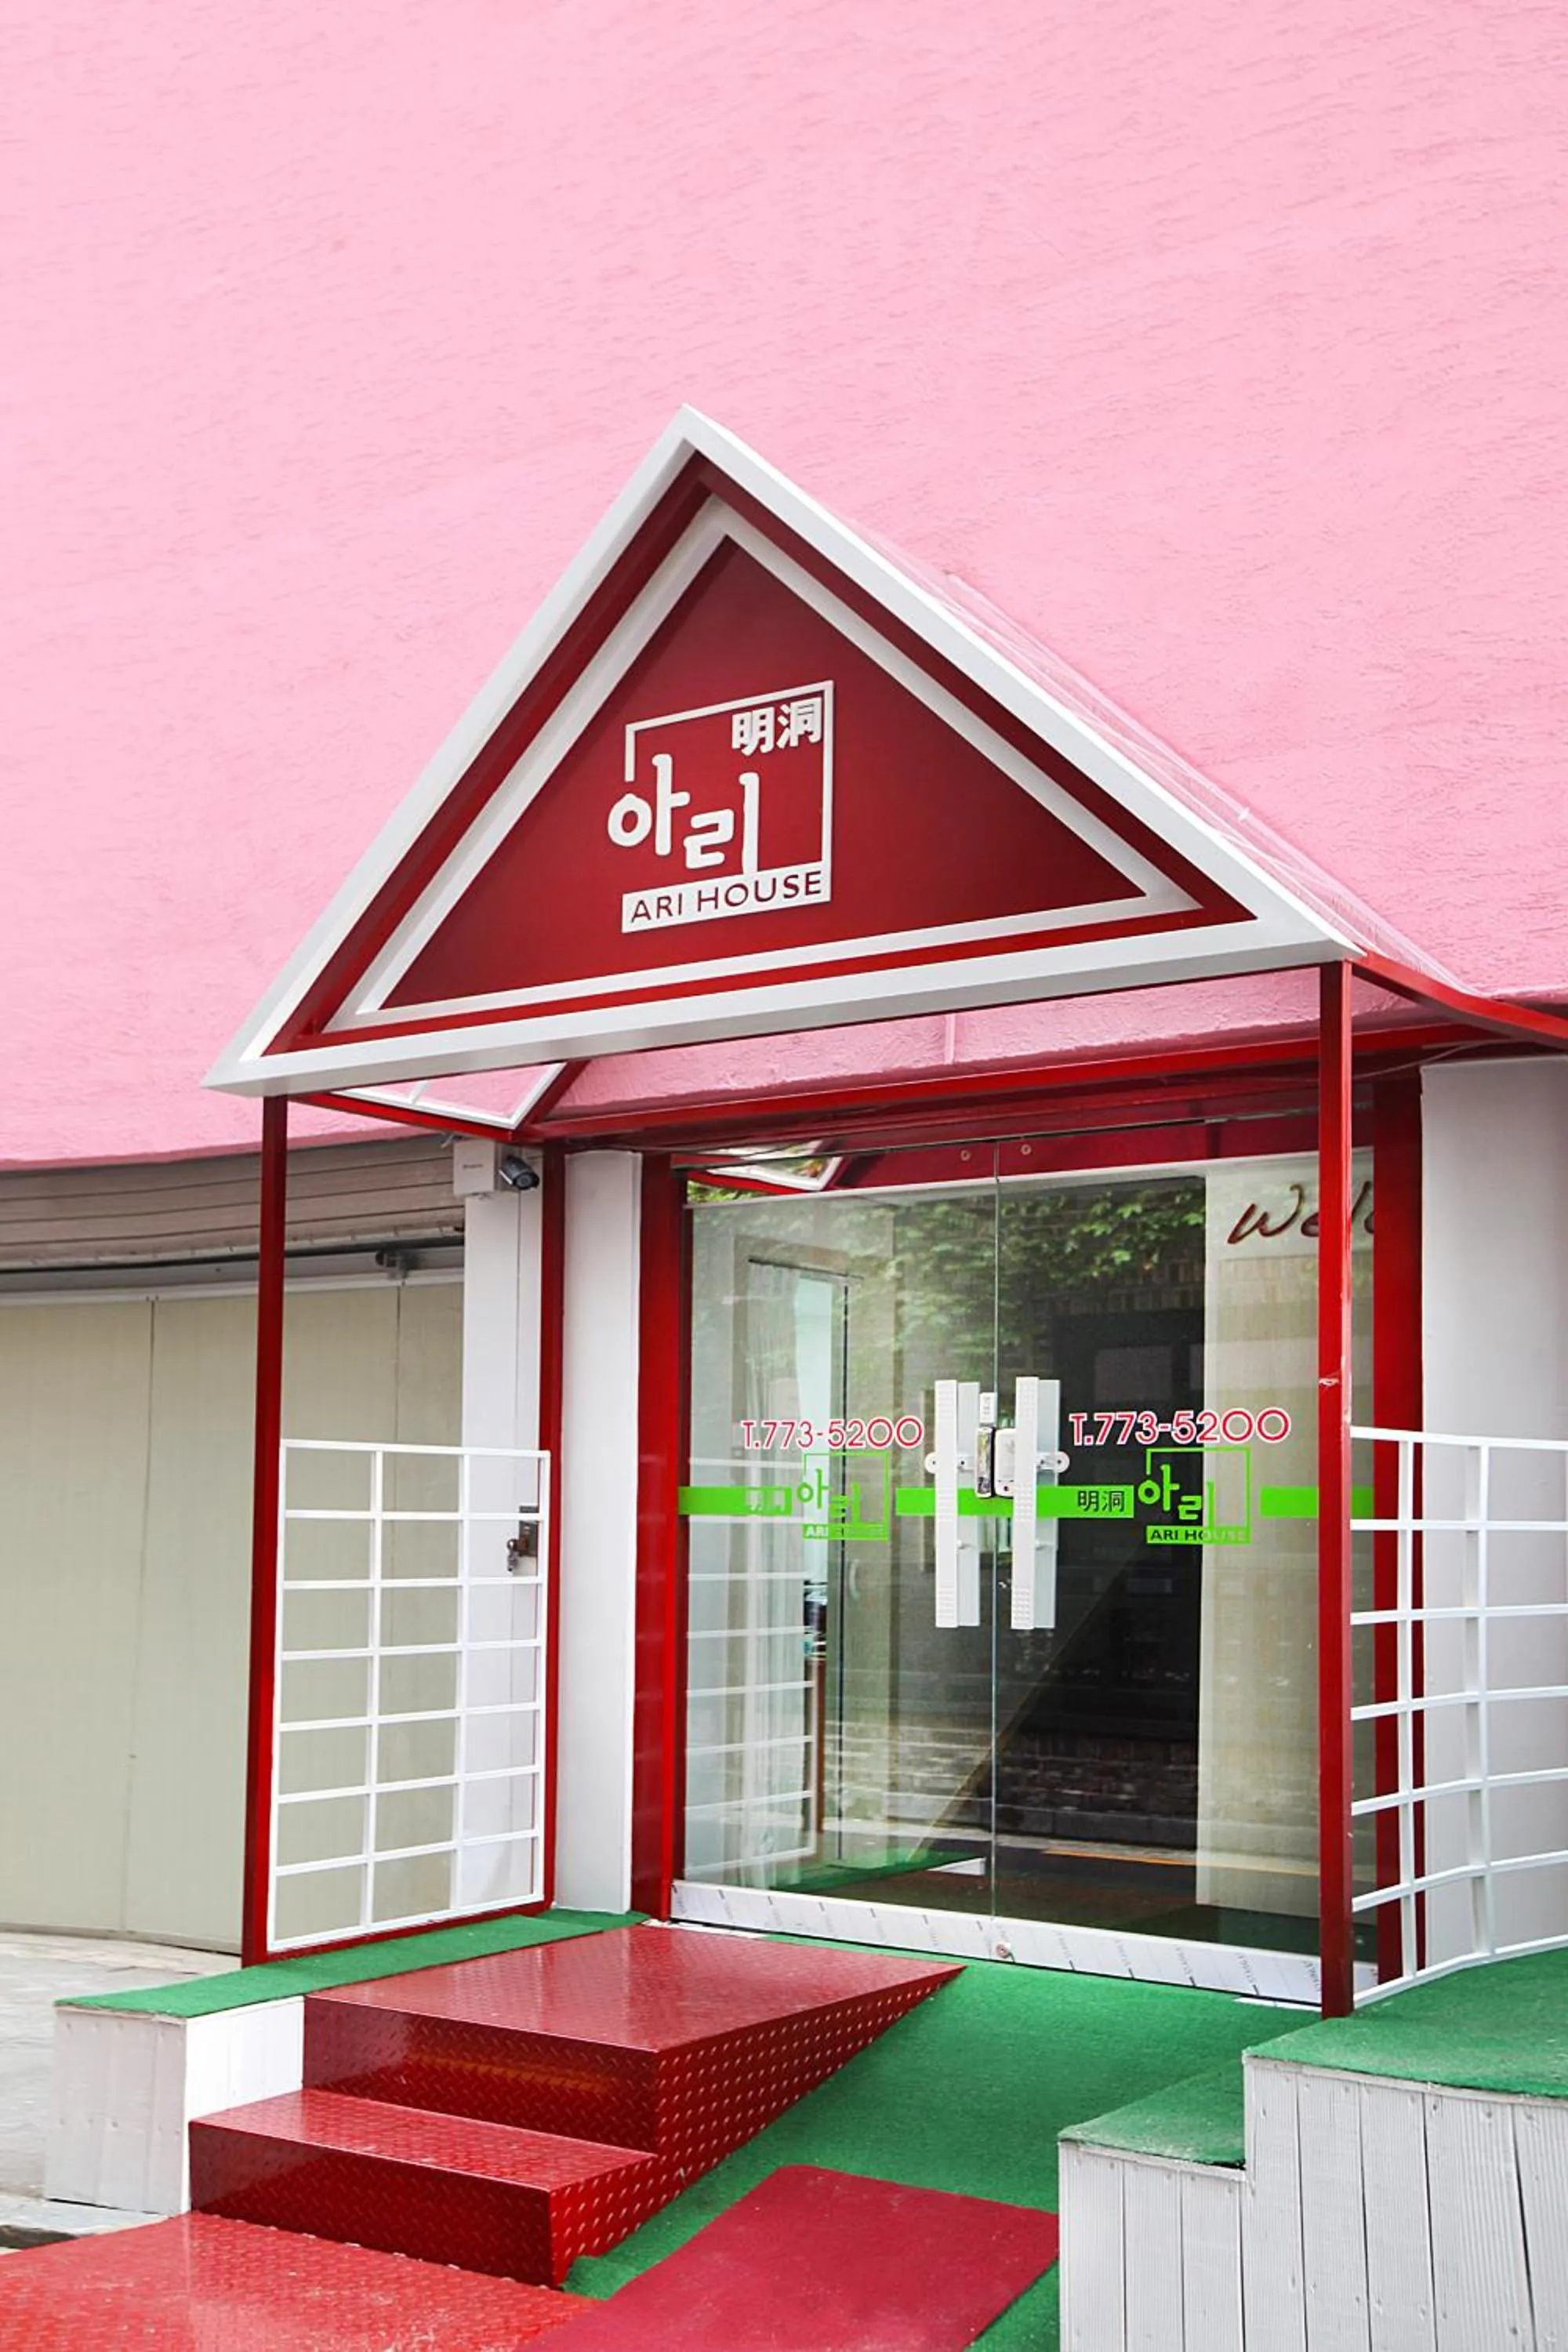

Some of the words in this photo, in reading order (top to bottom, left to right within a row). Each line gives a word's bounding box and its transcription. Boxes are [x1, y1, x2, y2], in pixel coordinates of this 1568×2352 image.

[731, 696, 822, 756] 明洞
[608, 753, 760, 875] 아리
[630, 893, 684, 923] ARI
[696, 870, 822, 912] HOUSE
[740, 1416, 924, 1450] T.773-5200
[1069, 1408, 1291, 1446] T.773-5200
[1077, 1490, 1126, 1513] 明洞
[1138, 1464, 1214, 1526] 아리
[1150, 1529, 1178, 1541] ARI
